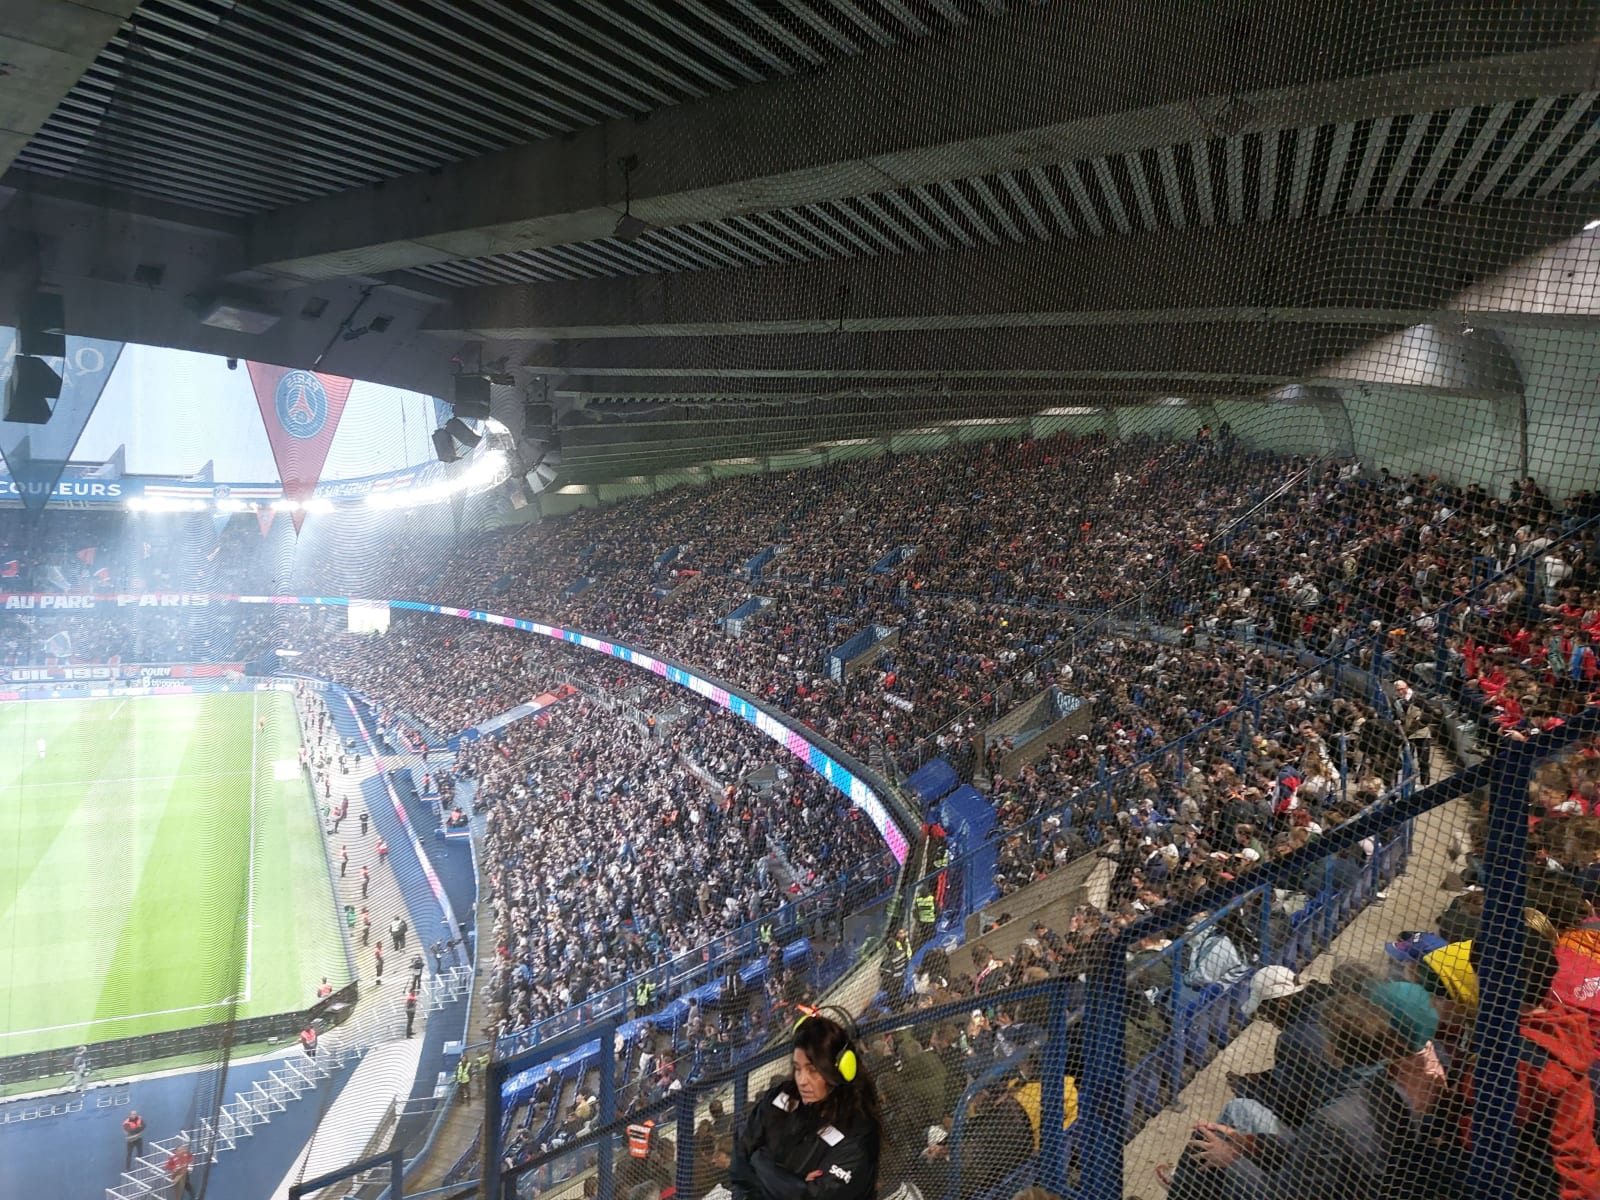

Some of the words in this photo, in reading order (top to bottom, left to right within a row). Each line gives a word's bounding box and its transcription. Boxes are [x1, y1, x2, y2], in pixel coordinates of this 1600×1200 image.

[6, 595, 35, 610] AU
[40, 594, 96, 609] PARC
[117, 594, 210, 607] PARIS
